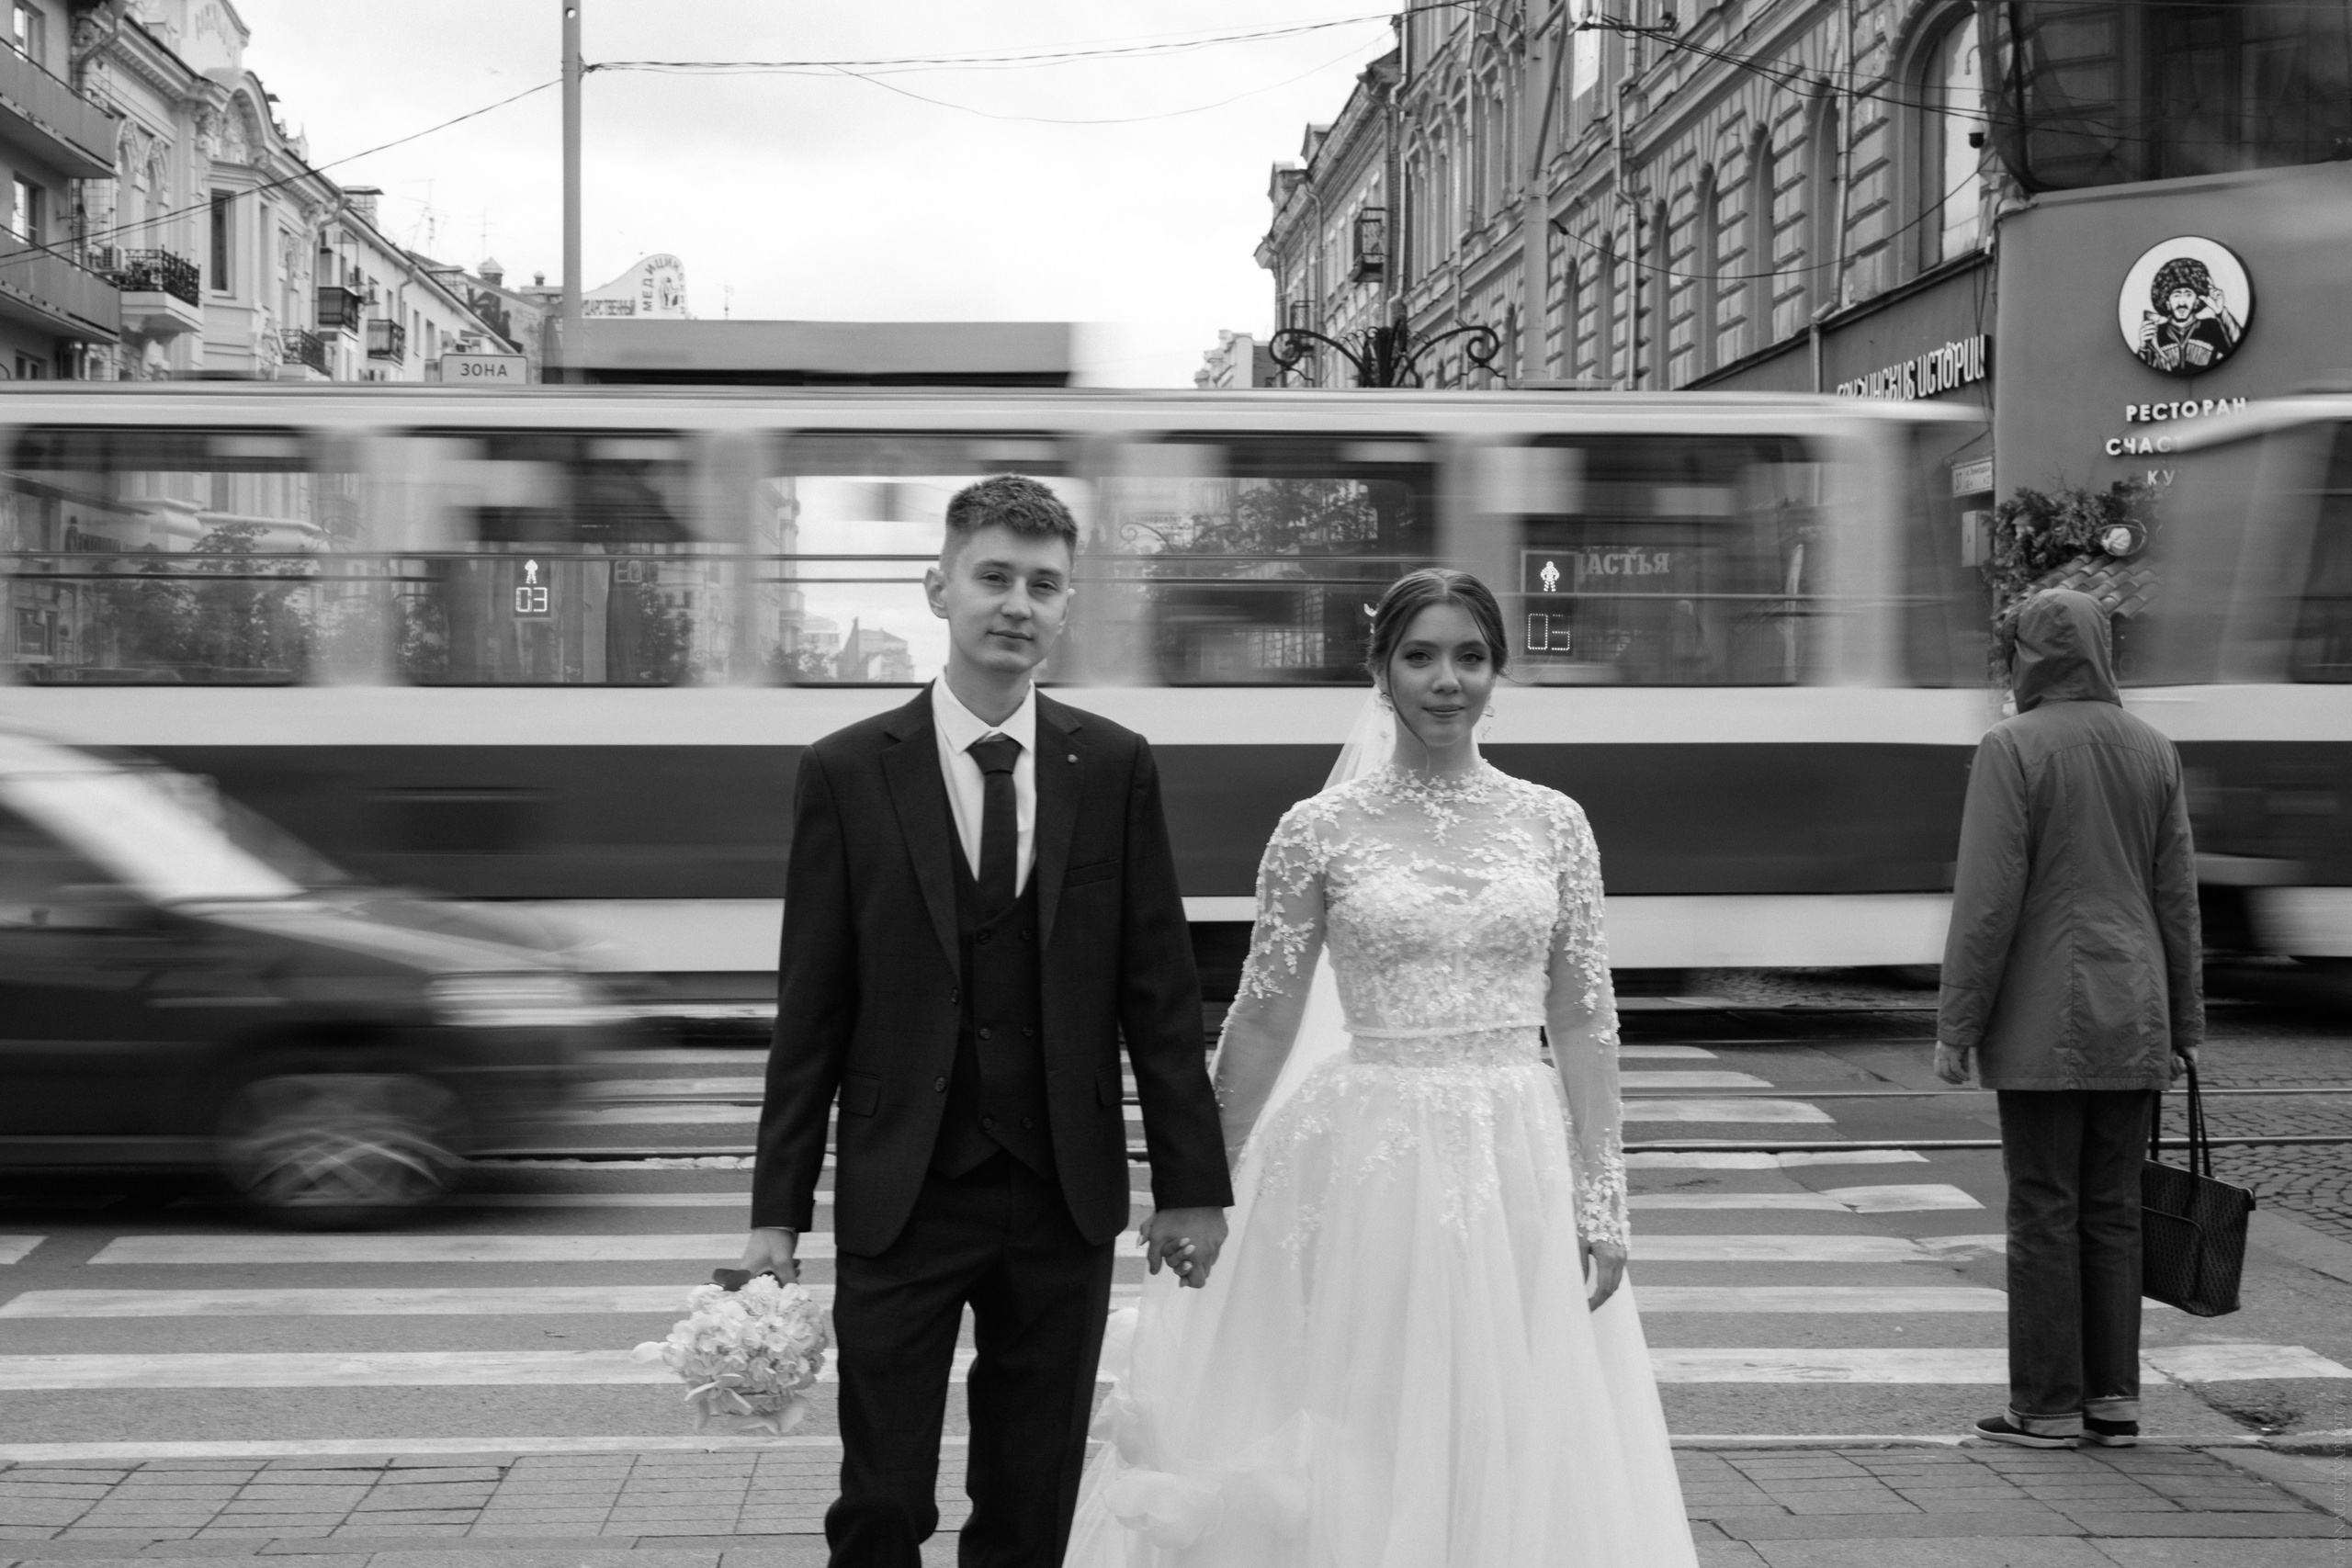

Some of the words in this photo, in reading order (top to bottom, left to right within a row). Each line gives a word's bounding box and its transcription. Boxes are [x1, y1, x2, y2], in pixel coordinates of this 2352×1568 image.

[460, 363, 508, 378] ЗОНА
[2125, 396, 2247, 423] РЕСТОРАН
[514, 586, 548, 614] 03
